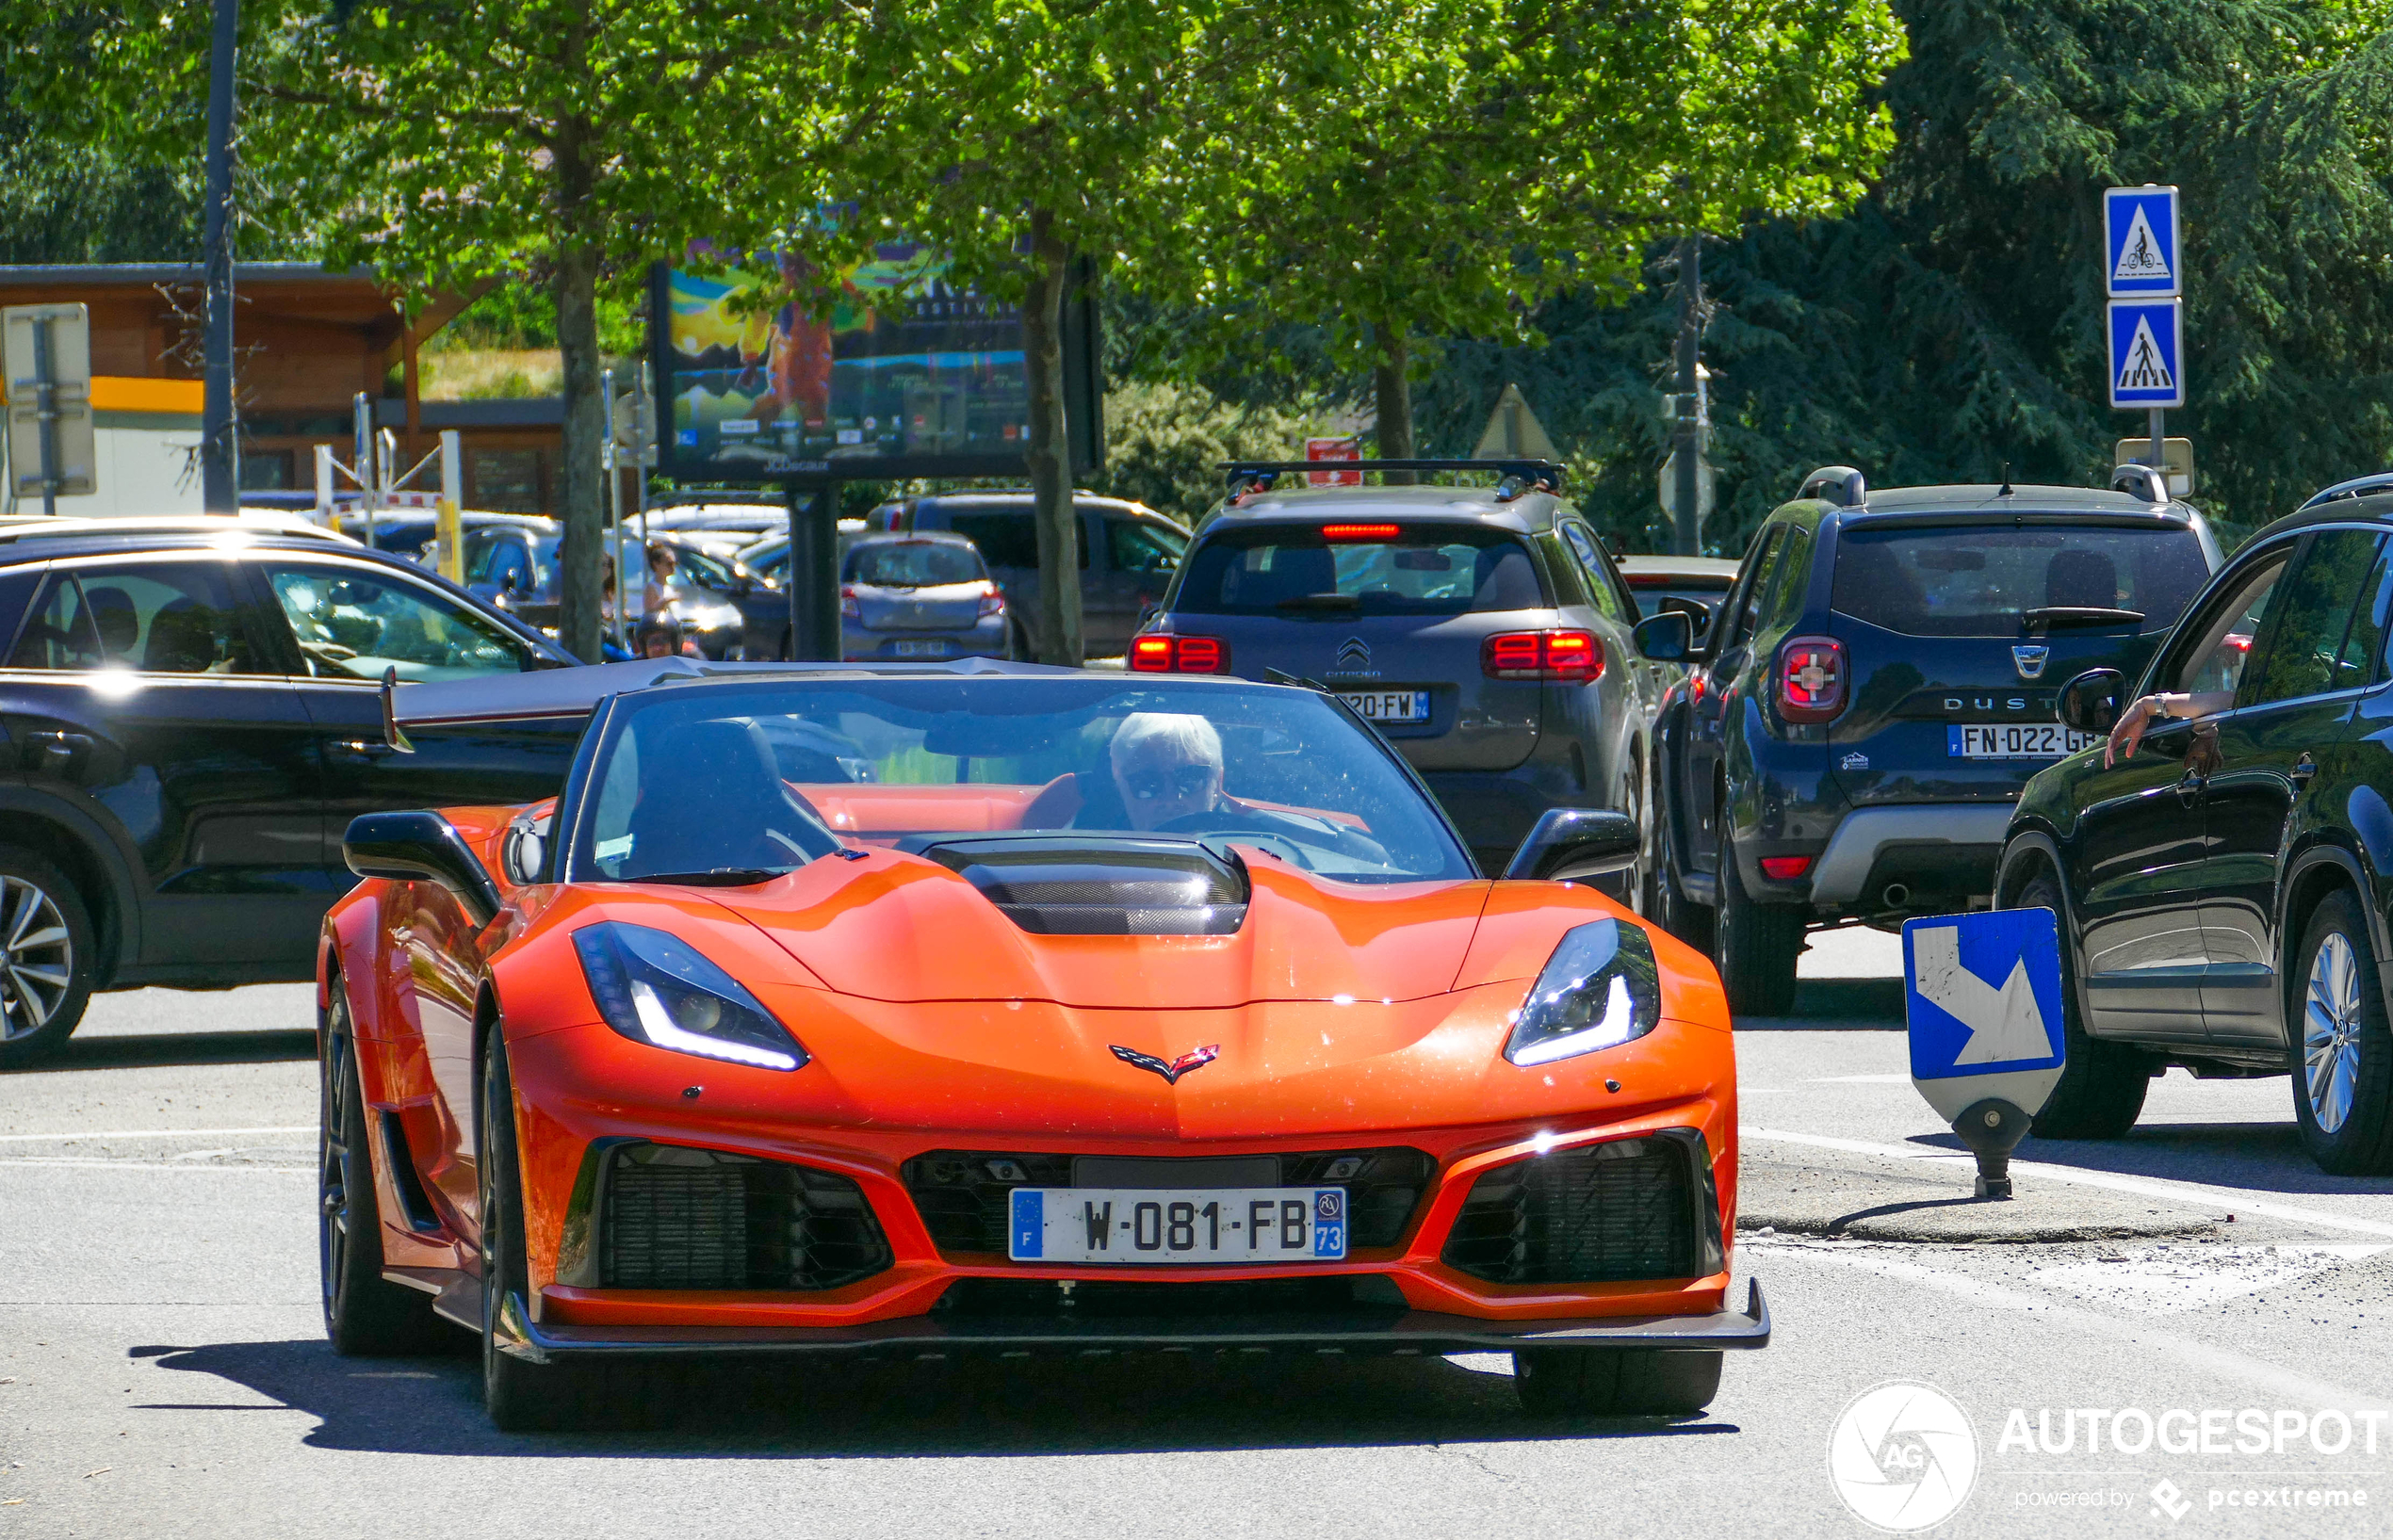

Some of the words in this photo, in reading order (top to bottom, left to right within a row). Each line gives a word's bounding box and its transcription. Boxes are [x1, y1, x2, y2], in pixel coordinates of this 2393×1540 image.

[765, 457, 829, 472] JCDecaux
[1343, 694, 1411, 718] 20-FW
[1416, 706, 1427, 718] 74
[1084, 1200, 1306, 1251] W-081-FB
[1022, 1232, 1032, 1246] F
[1316, 1226, 1342, 1251] 73
